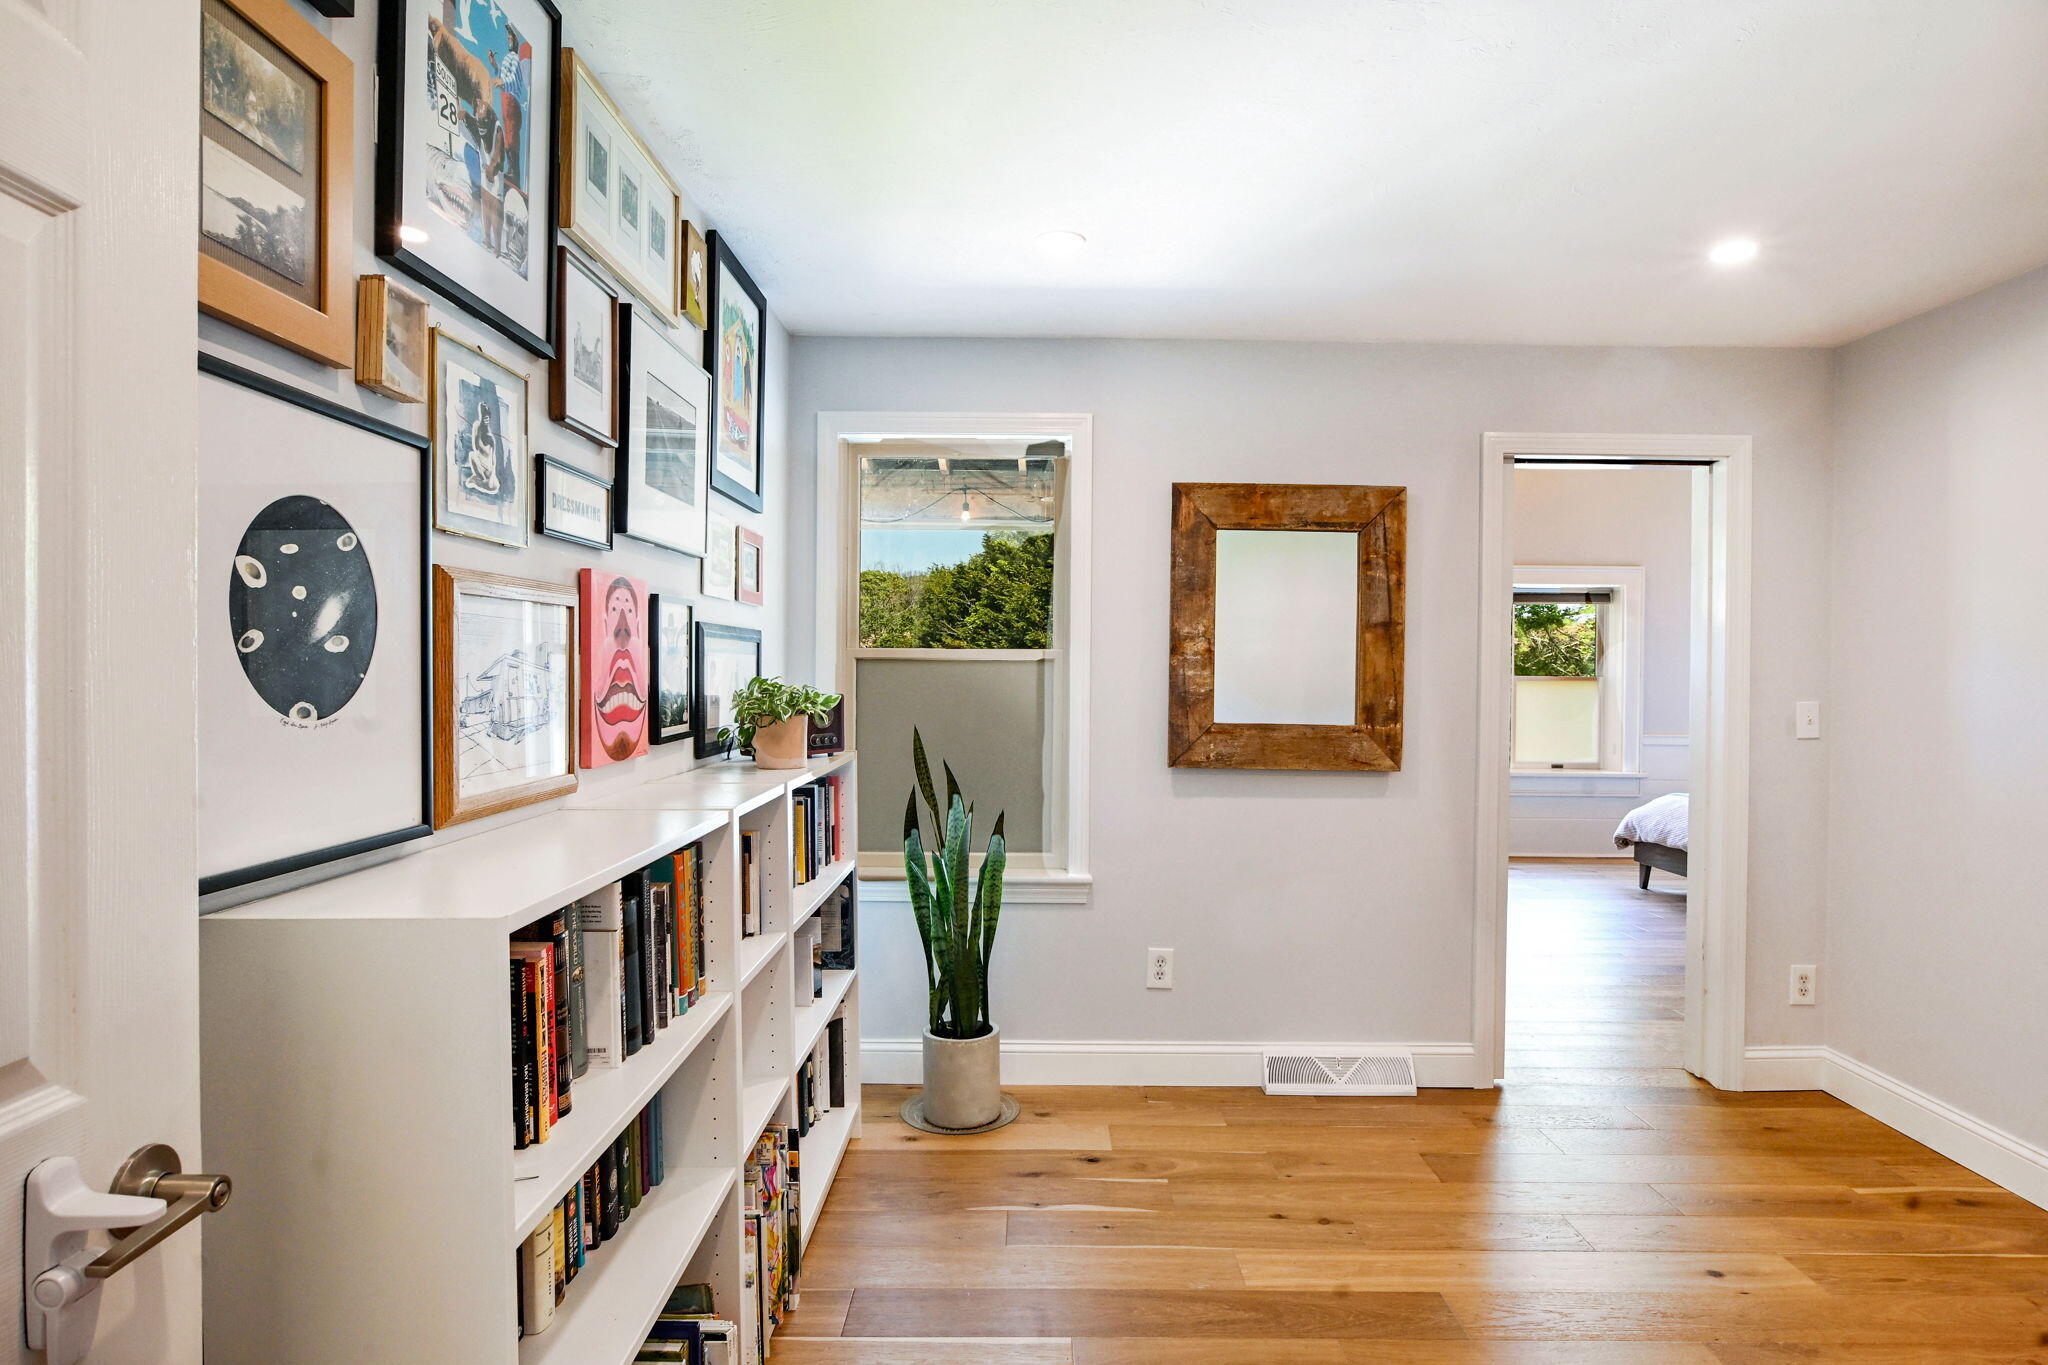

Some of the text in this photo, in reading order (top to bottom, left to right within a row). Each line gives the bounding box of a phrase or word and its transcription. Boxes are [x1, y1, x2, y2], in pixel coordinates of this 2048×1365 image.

[437, 62, 457, 89] SOUTH
[440, 93, 457, 126] 28
[552, 492, 601, 522] DRESSMAKING
